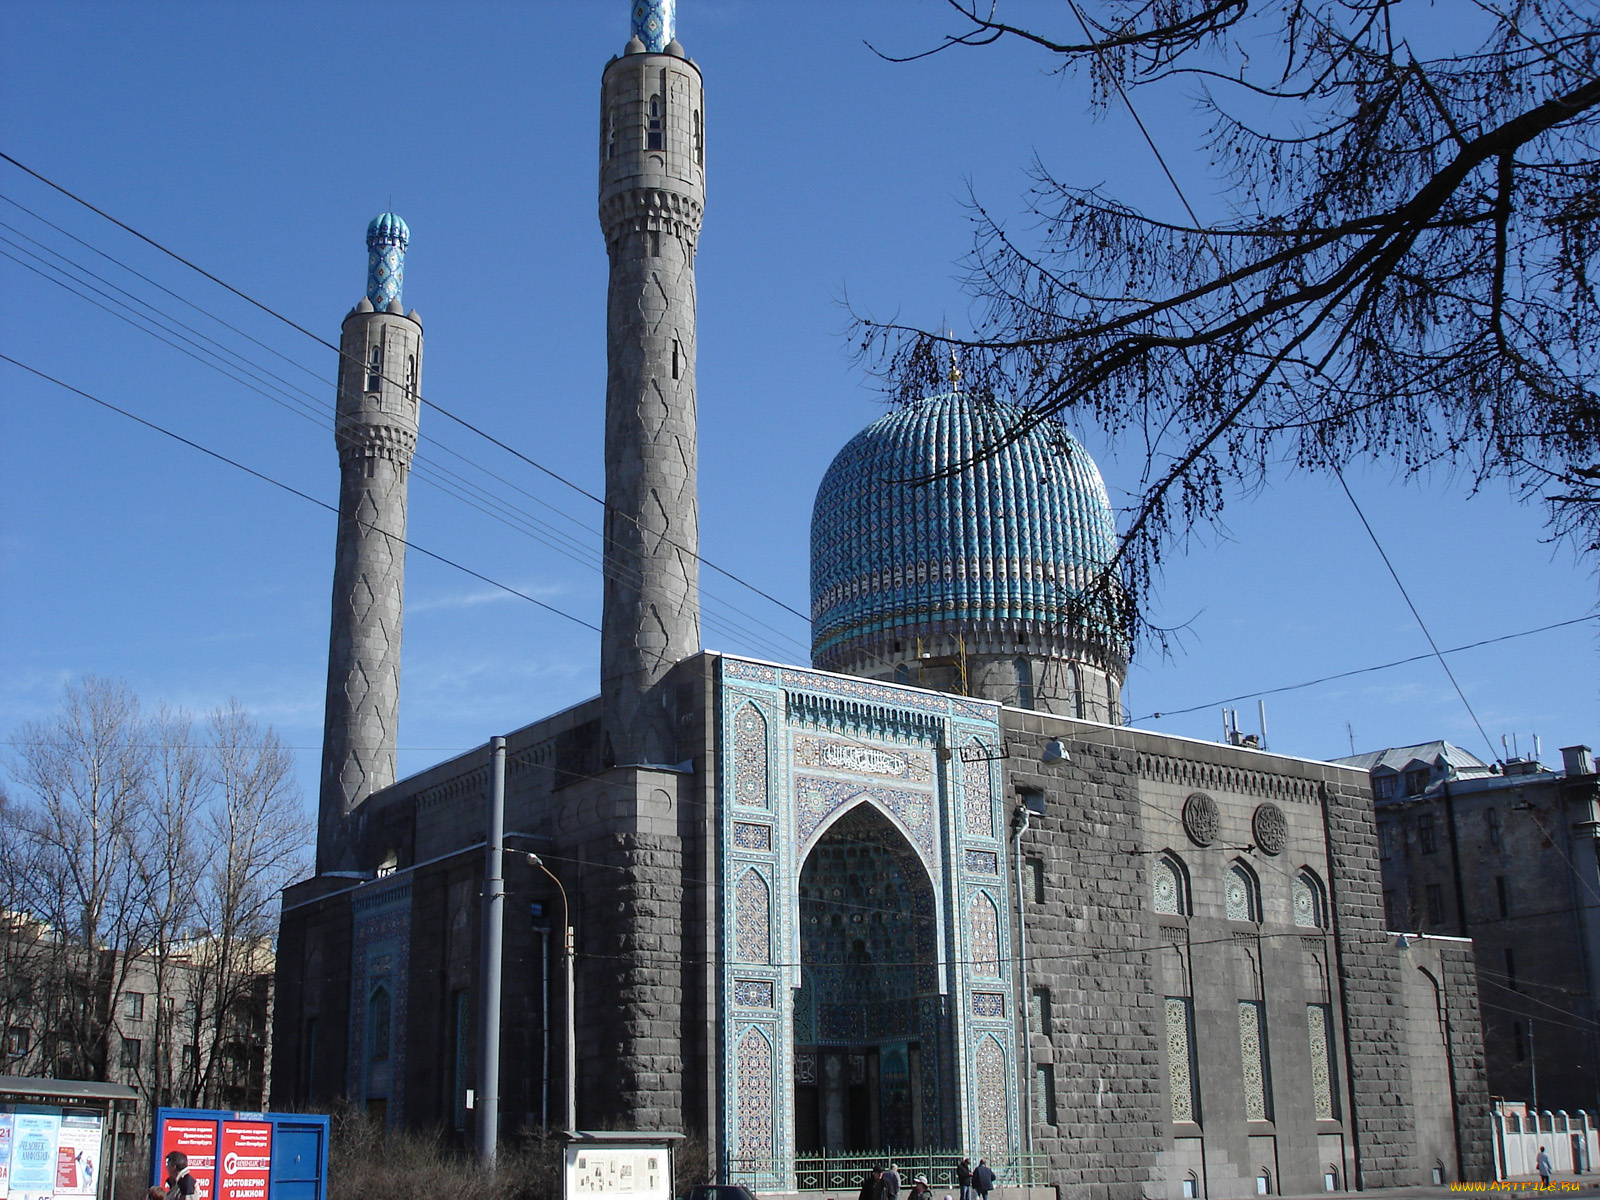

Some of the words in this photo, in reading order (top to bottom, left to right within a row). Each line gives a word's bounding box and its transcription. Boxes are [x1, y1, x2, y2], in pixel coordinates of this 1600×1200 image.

[223, 1179, 265, 1188] ДОСТОВЕРНО
[230, 1190, 236, 1198] О
[236, 1190, 264, 1198] ВАЖНОМ
